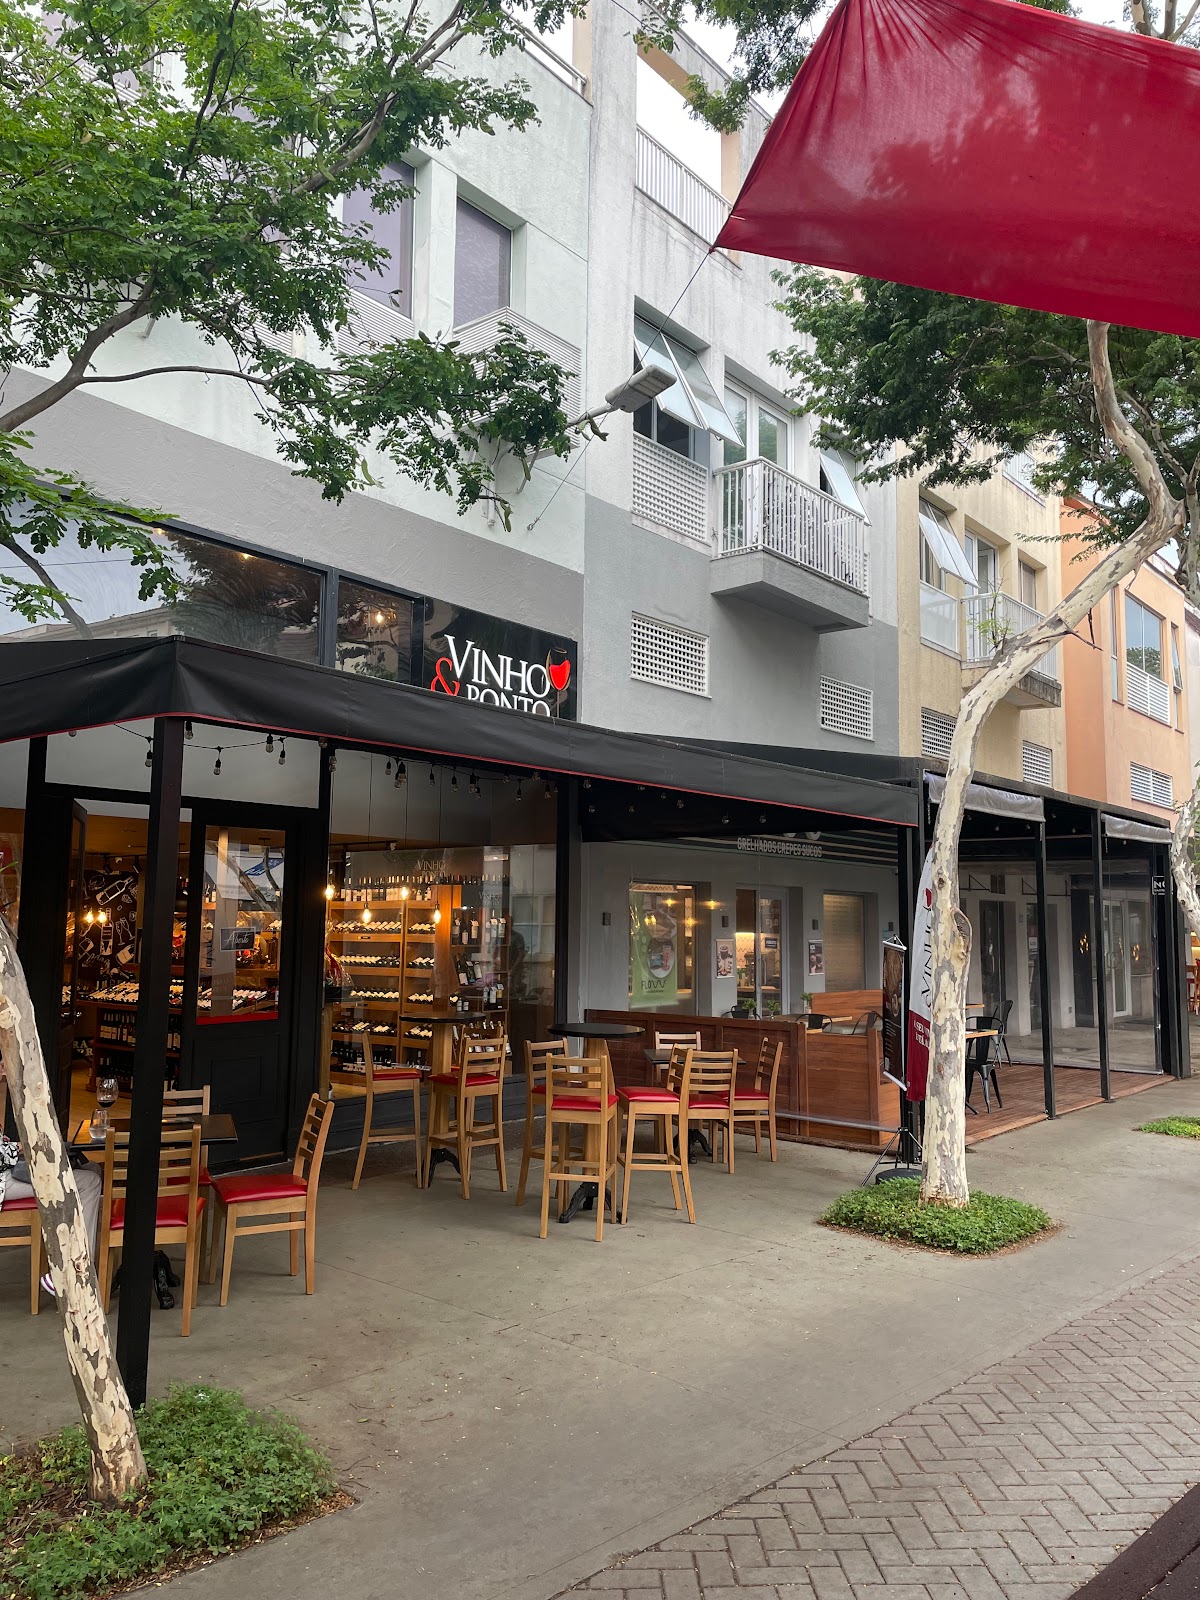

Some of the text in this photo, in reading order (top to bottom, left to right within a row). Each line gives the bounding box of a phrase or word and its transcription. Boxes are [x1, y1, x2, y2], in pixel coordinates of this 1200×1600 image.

[430, 656, 460, 697] &
[444, 634, 551, 698] VINHO
[737, 837, 823, 858] GRELHADOS CREPES SUCOS
